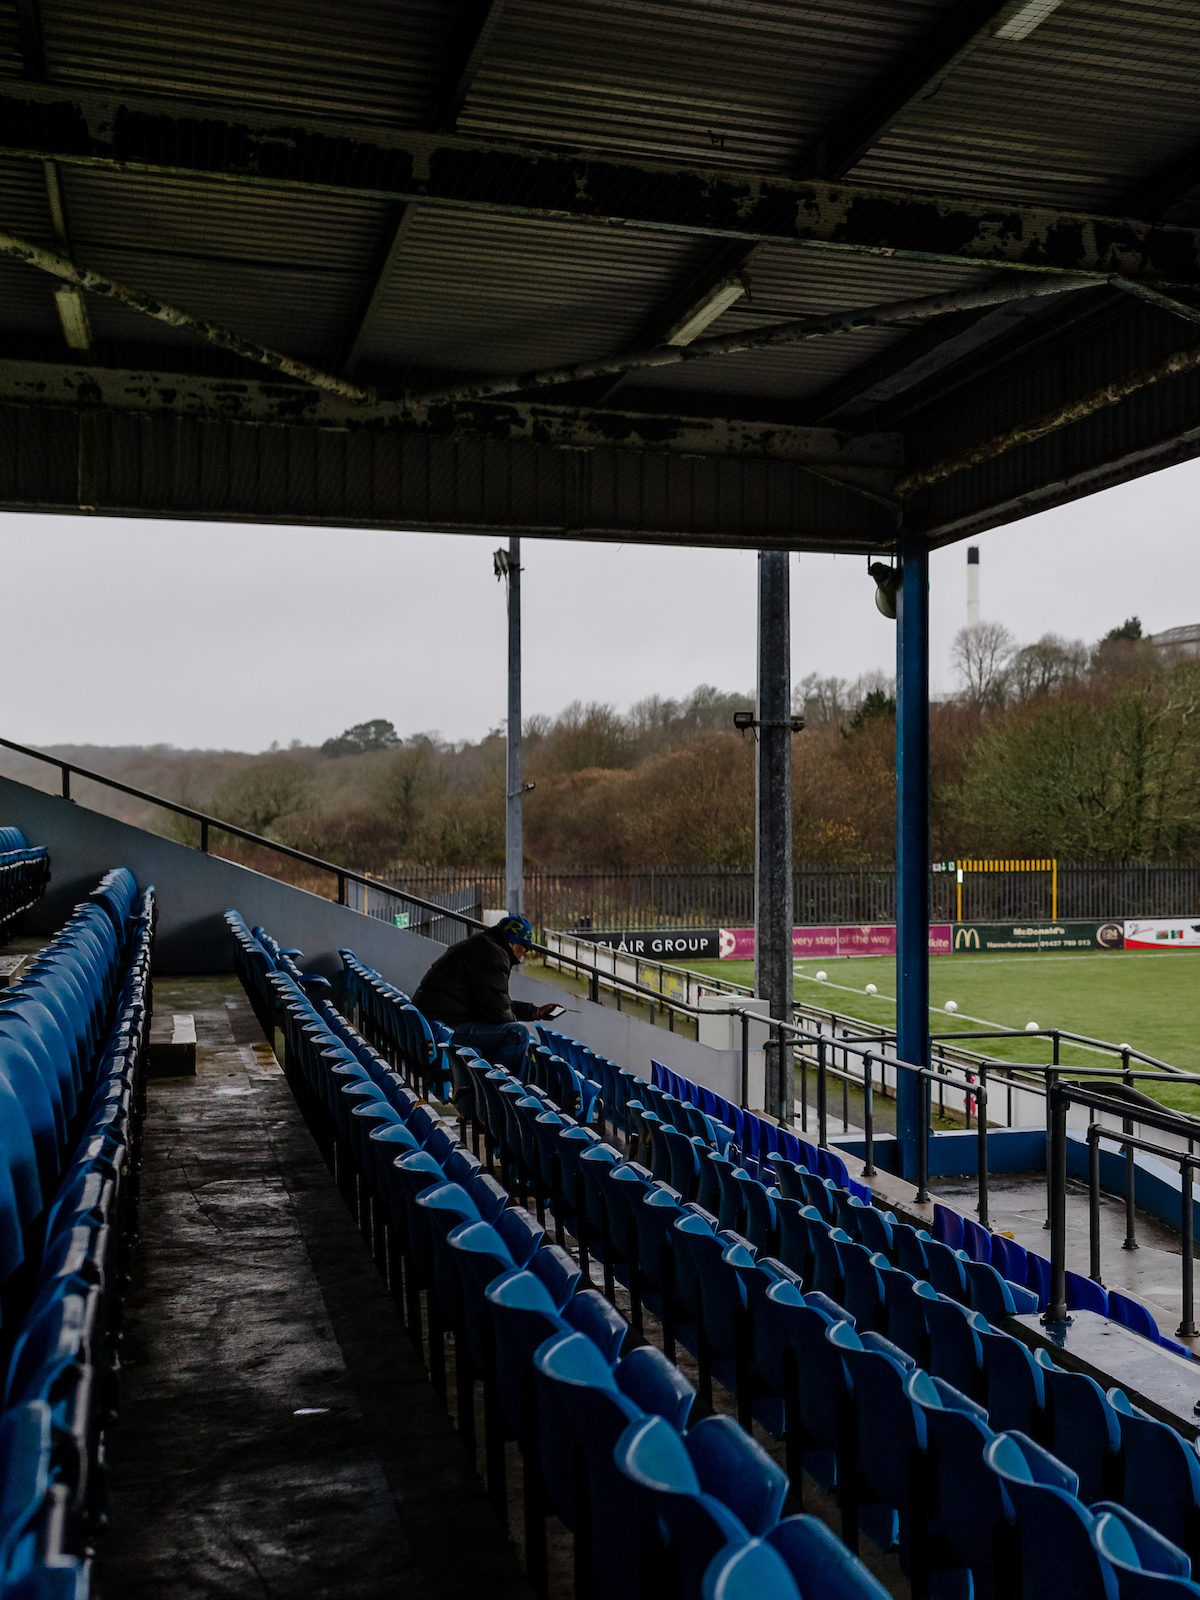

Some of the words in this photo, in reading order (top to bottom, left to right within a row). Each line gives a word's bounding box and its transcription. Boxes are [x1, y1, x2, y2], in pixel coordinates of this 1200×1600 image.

[1013, 927, 1065, 936] McDonald's
[1105, 929, 1118, 938] 24
[651, 938, 709, 953] GROUP
[815, 936, 837, 947] step
[840, 935, 849, 944] of
[852, 935, 869, 944] the
[870, 936, 891, 946] way
